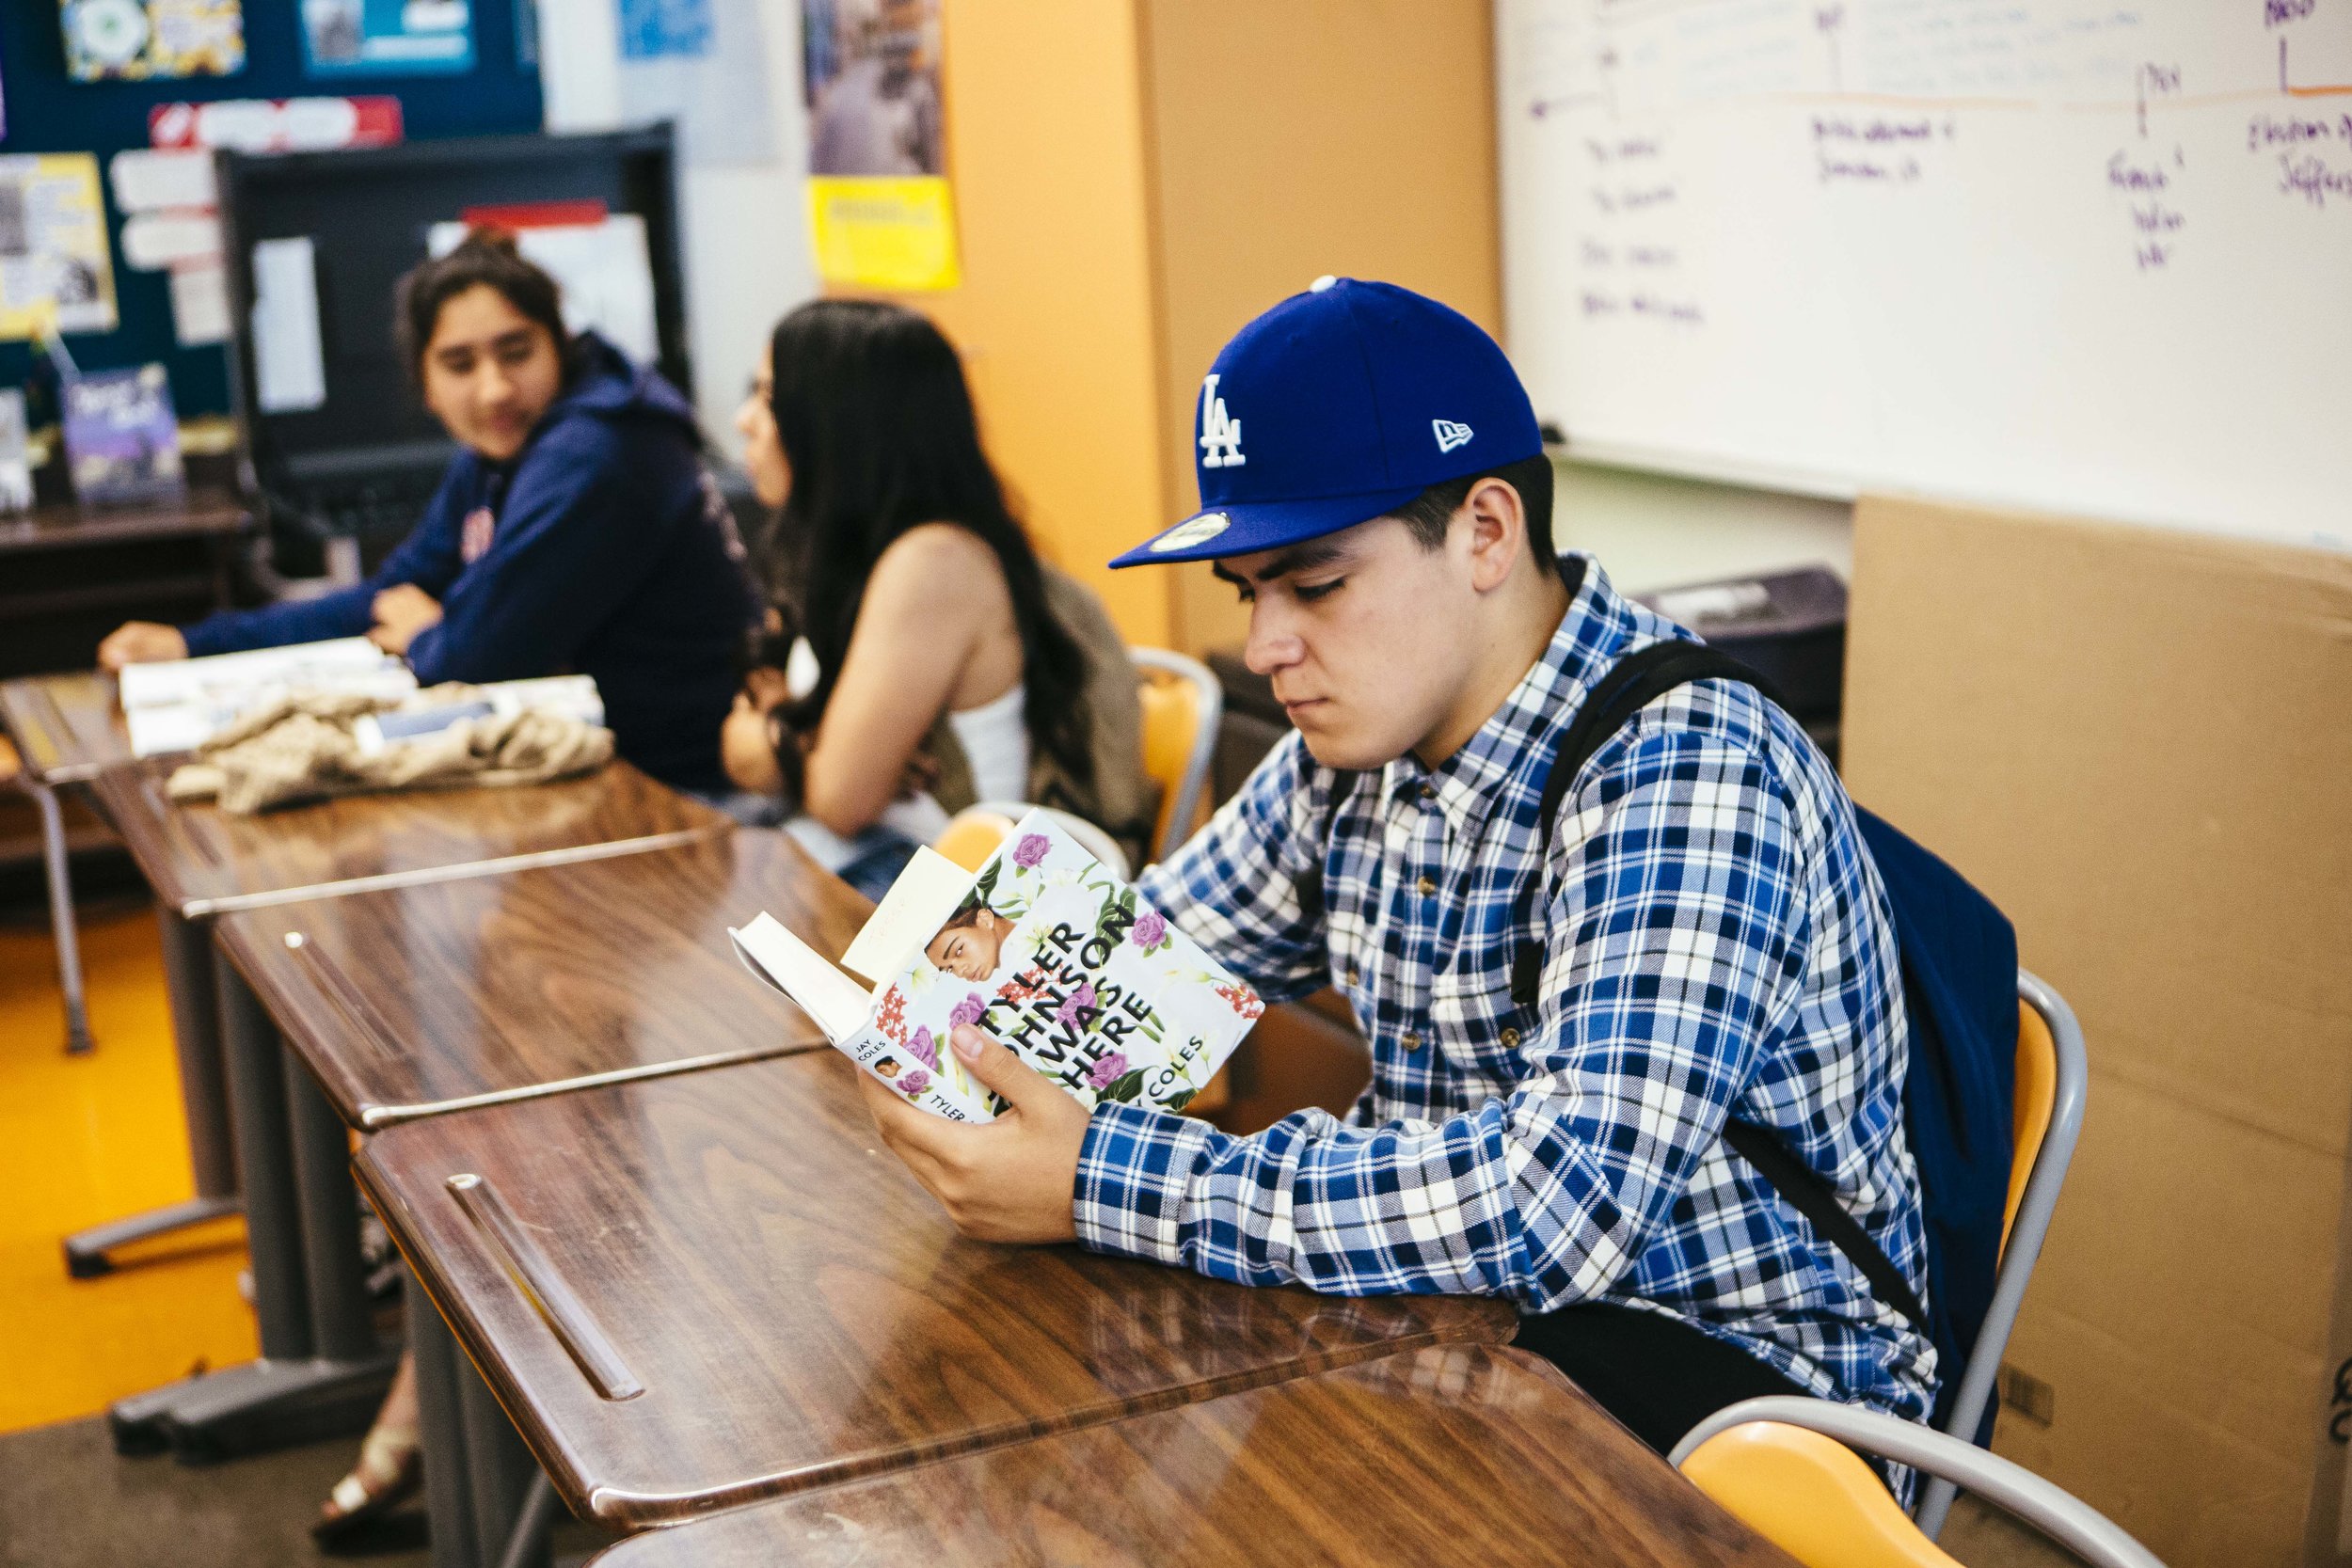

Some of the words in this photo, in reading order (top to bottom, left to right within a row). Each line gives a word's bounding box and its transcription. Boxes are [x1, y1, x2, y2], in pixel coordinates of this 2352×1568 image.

[1200, 374, 1246, 467] LA
[974, 922, 1086, 1037] TYLER
[988, 904, 1136, 1100] HNSON
[1035, 976, 1121, 1063] WAS
[855, 1039, 871, 1053] JAY
[858, 1041, 886, 1062] COLES
[1059, 991, 1152, 1090] HERE
[1149, 1036, 1203, 1097] COLES
[930, 1095, 966, 1121] TYLER
